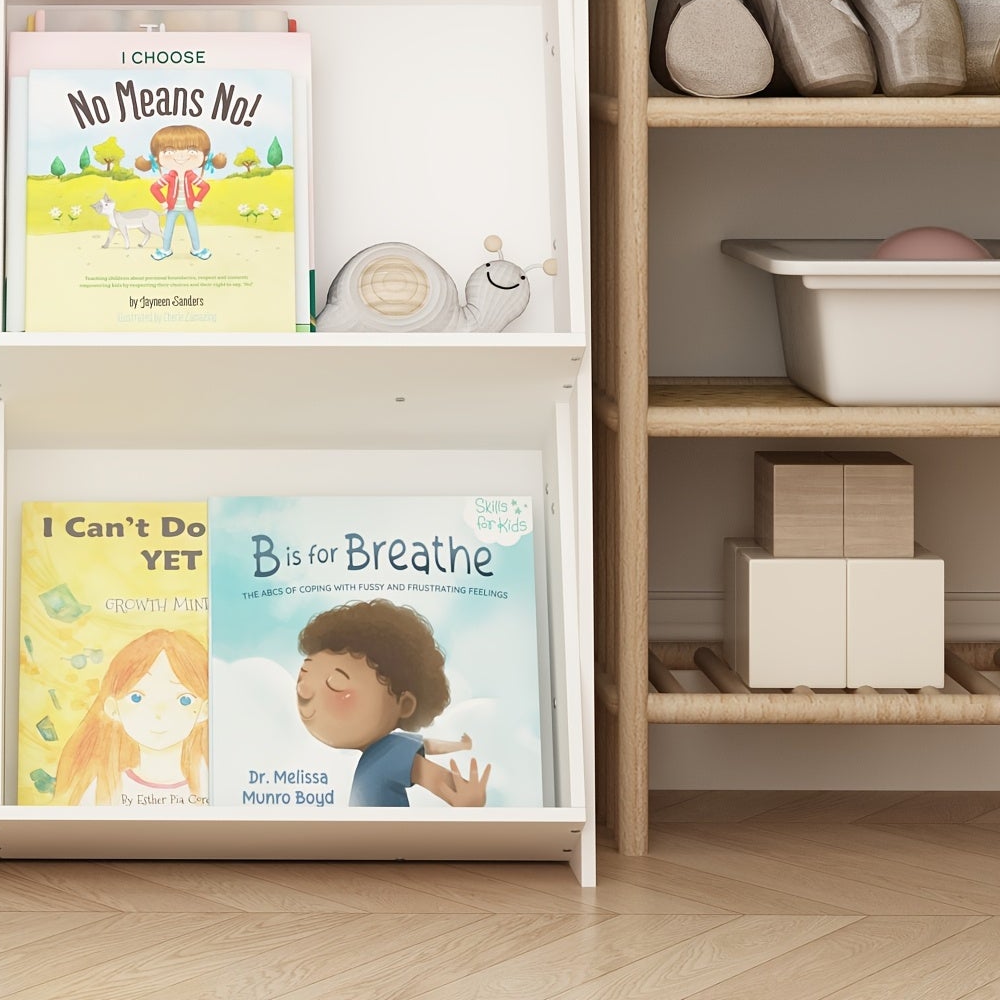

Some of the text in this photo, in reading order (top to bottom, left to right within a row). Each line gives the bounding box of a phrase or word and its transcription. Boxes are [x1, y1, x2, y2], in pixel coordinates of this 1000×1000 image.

[122, 51, 206, 64] I CHOOSE
[67, 80, 262, 129] No Means No!
[129, 295, 204, 309] by Jayneen Sanders
[475, 498, 508, 514] Skills
[43, 516, 206, 538] I Can't Do
[477, 515, 528, 533] for Kids
[141, 550, 203, 570] YET
[251, 533, 494, 578] B is for Breathe
[242, 583, 508, 600] THE ABCS OF COPING WITH FUSSY AND FRUSTRATING FEELINGS
[105, 597, 167, 614] GROWTH
[249, 770, 328, 784] Dr. Melissa
[121, 793, 133, 806] By
[137, 794, 167, 805] Esther
[170, 794, 185, 804] Pia
[243, 790, 334, 807] Munro Boyd
